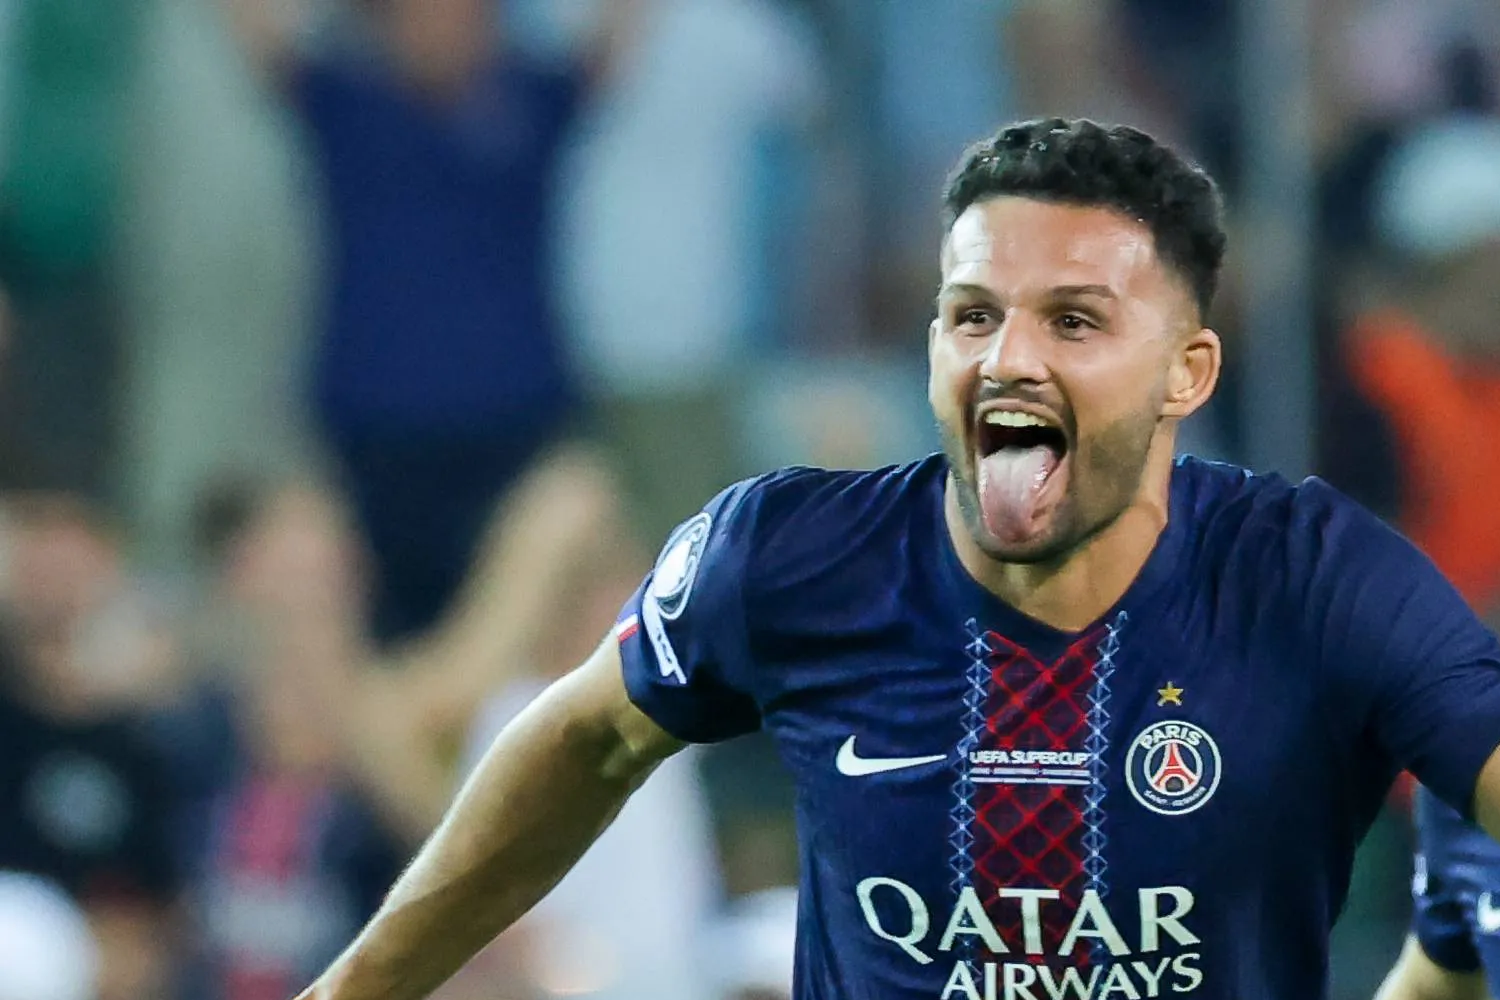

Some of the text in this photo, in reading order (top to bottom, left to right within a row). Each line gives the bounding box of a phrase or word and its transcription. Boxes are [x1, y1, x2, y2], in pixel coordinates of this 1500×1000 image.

[1140, 725, 1202, 749] PARIS
[969, 750, 1009, 764] UEFA
[856, 876, 1201, 965] QATAR
